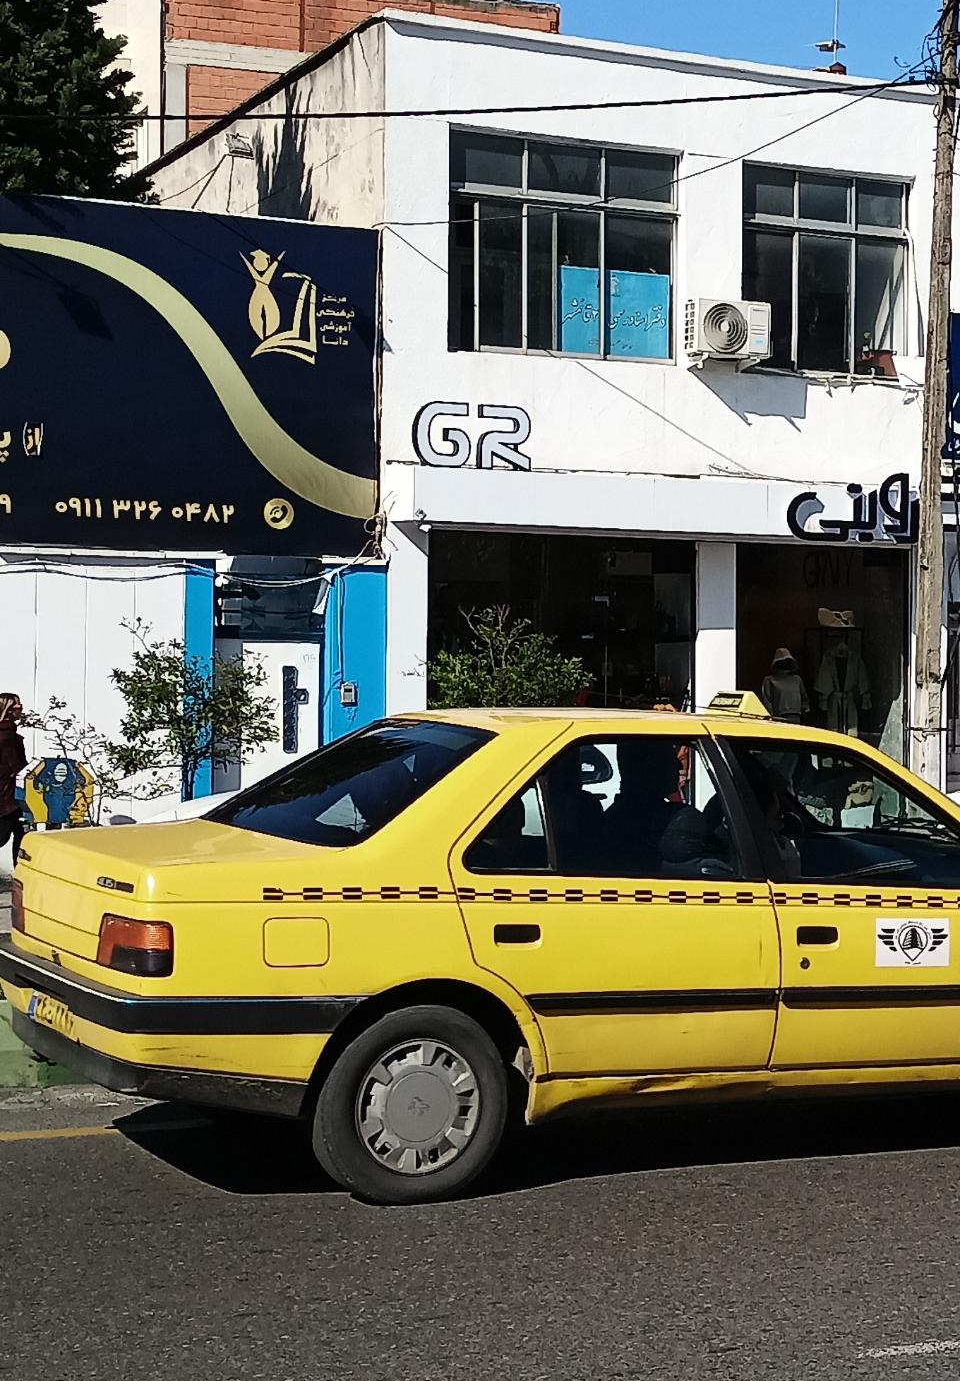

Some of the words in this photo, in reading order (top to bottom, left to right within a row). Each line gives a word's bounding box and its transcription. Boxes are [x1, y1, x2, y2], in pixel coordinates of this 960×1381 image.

[320, 321, 352, 334] آموزشی
[322, 335, 349, 346] دانا
[412, 400, 532, 472] GR
[55, 497, 102, 518] ۰۹۱۱
[112, 499, 162, 520] ۳۲۶
[171, 502, 235, 523] ۰۴۸۲
